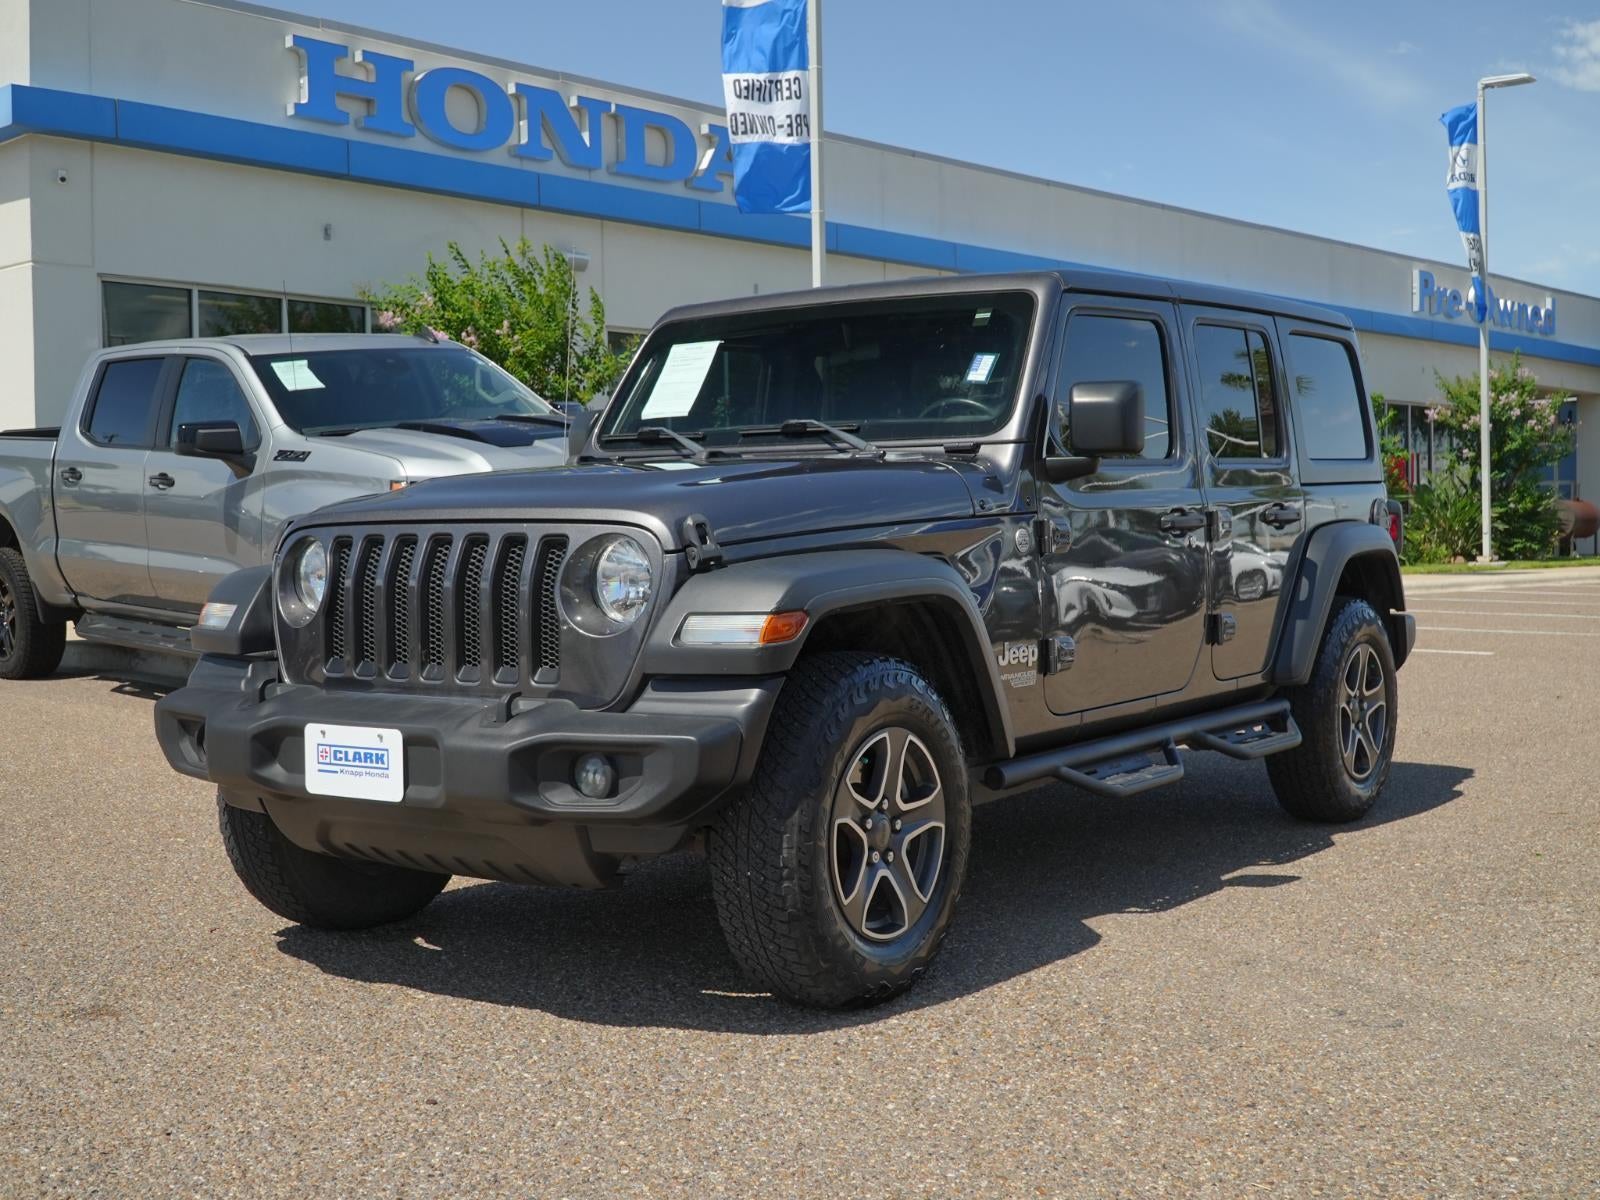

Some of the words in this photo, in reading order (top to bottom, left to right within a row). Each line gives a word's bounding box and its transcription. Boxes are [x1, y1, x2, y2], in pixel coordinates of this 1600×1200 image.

[998, 642, 1039, 667] Jeep
[333, 749, 386, 765] CLARK
[339, 768, 364, 778] Knapp
[365, 769, 390, 779] Honda
